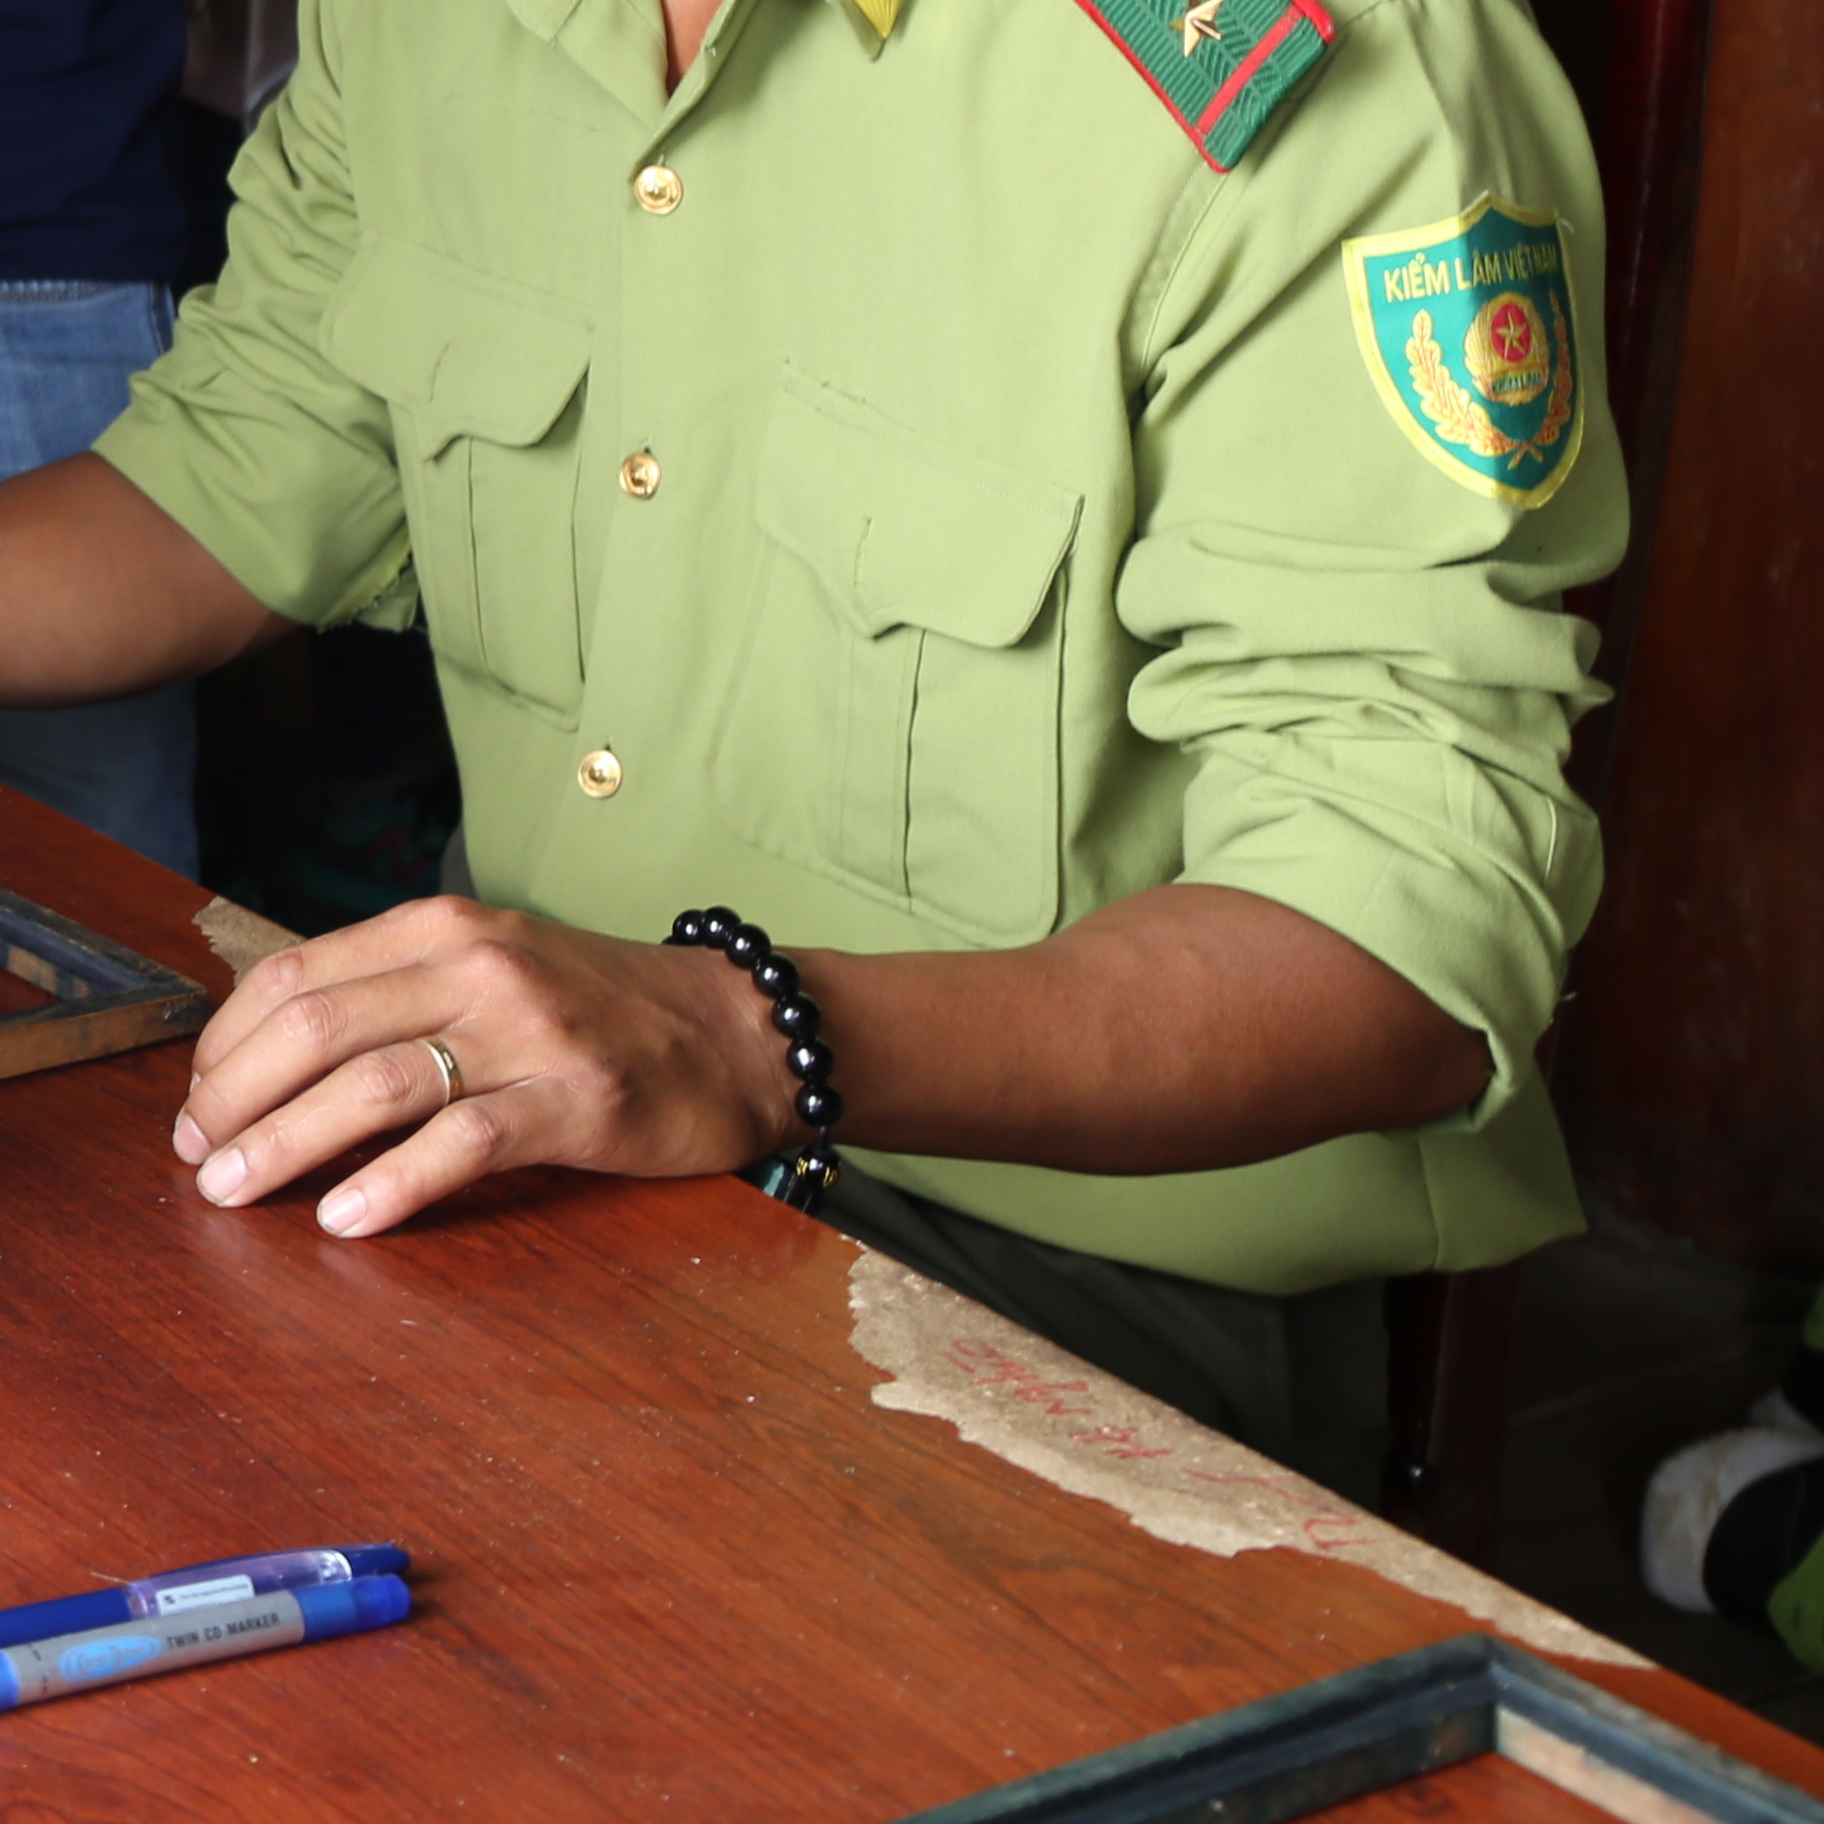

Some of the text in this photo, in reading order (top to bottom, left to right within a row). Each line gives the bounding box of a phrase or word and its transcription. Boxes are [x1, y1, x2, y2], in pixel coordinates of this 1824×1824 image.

[1383, 251, 1450, 304] KIỂM
[1454, 249, 1502, 292] LÂM
[167, 1632, 200, 1650] TWIN
[227, 1612, 281, 1635] MARKER
